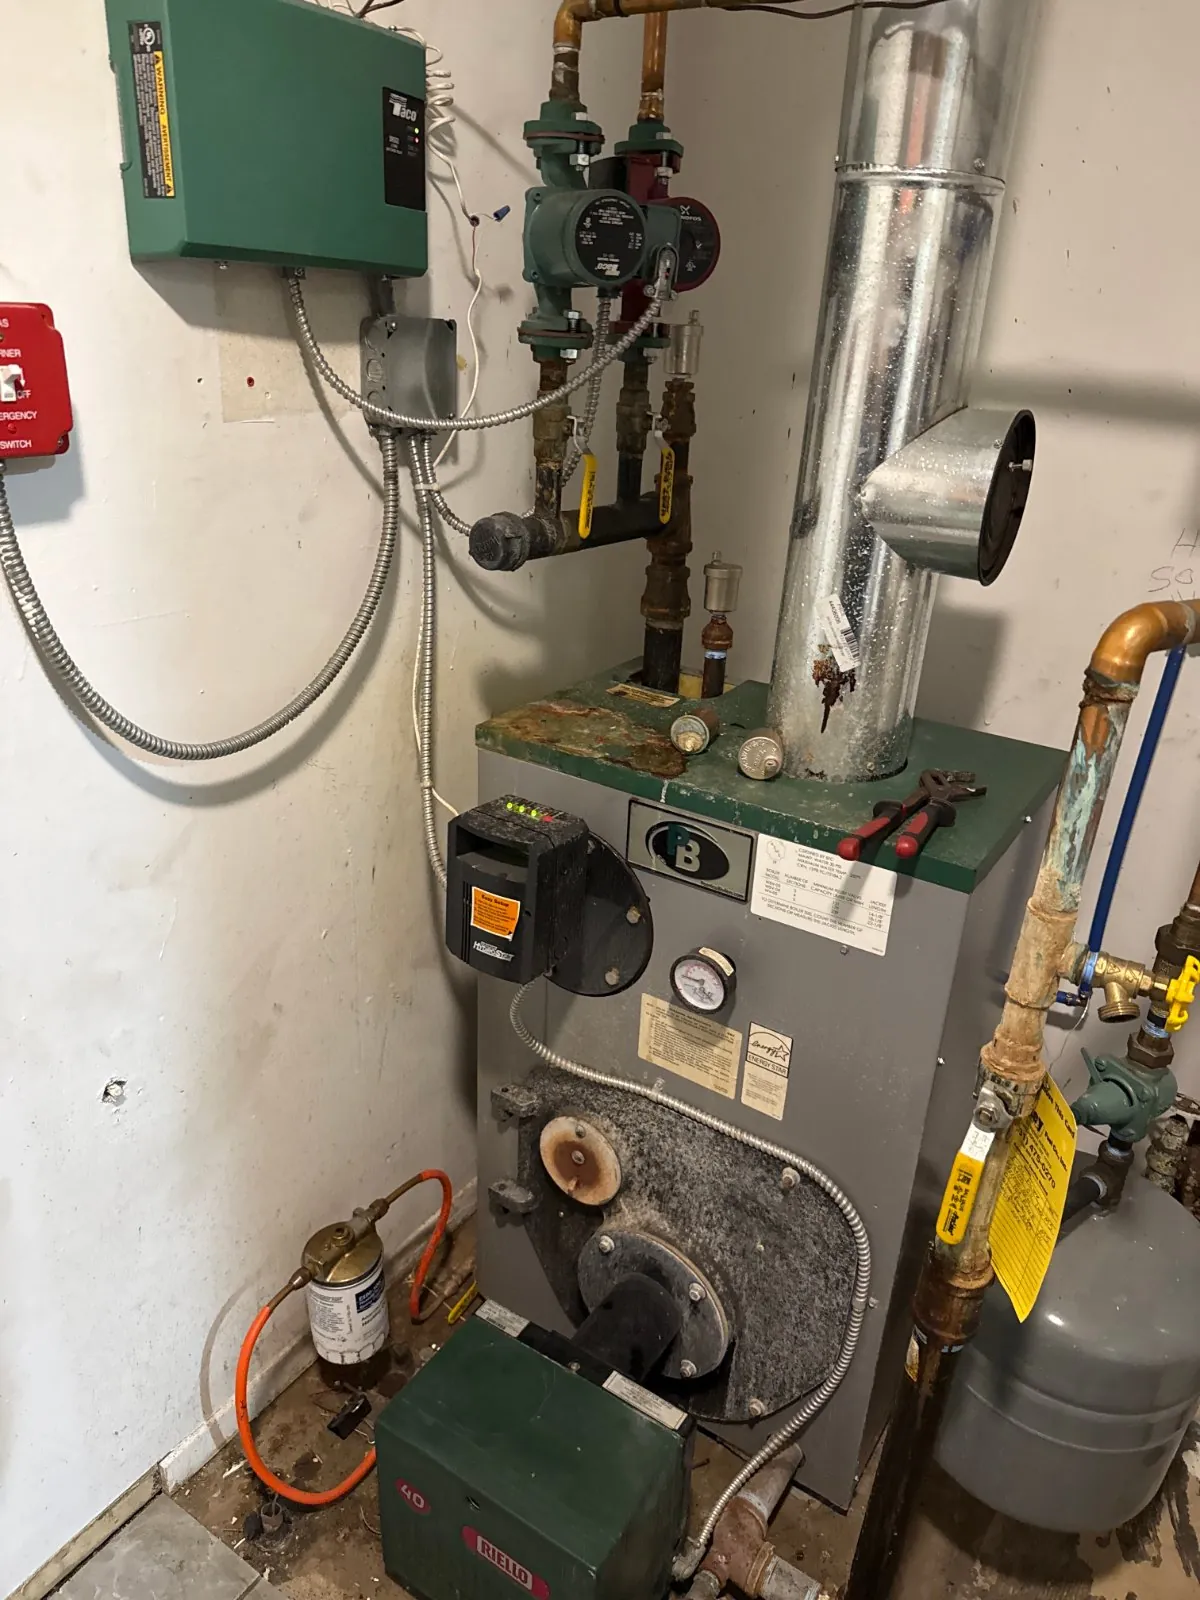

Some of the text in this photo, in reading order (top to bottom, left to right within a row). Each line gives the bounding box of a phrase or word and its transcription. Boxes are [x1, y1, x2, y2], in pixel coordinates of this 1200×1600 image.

[157, 67, 166, 115] WARNING
[389, 93, 417, 122] Taco
[0, 439, 32, 450] SWITCH
[748, 1054, 788, 1075] ENERGY STAR
[401, 1484, 425, 1509] 40
[481, 1540, 528, 1585] RIELLO
